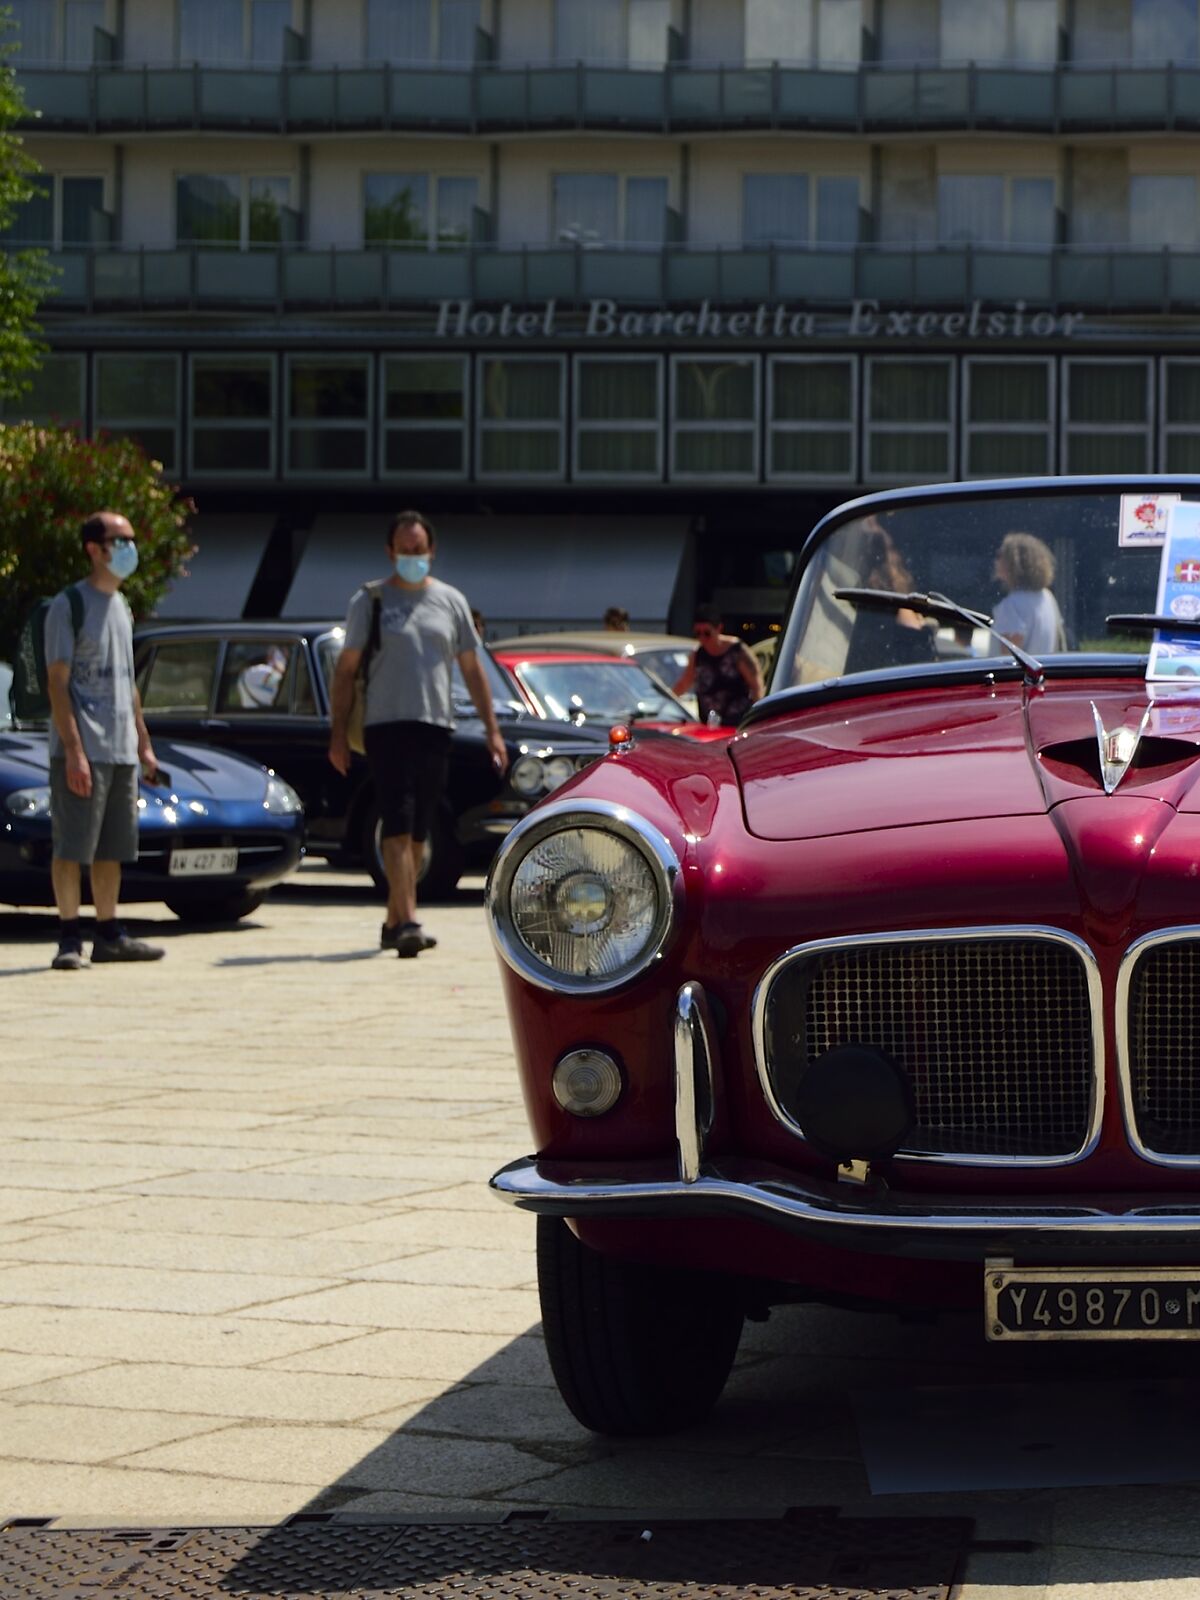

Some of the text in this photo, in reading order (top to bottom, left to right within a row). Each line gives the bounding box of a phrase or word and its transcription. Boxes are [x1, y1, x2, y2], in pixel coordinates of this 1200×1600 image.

[434, 299, 1084, 337] Hotel Barchetta Excelsior
[1009, 1287, 1161, 1326] Y49870
